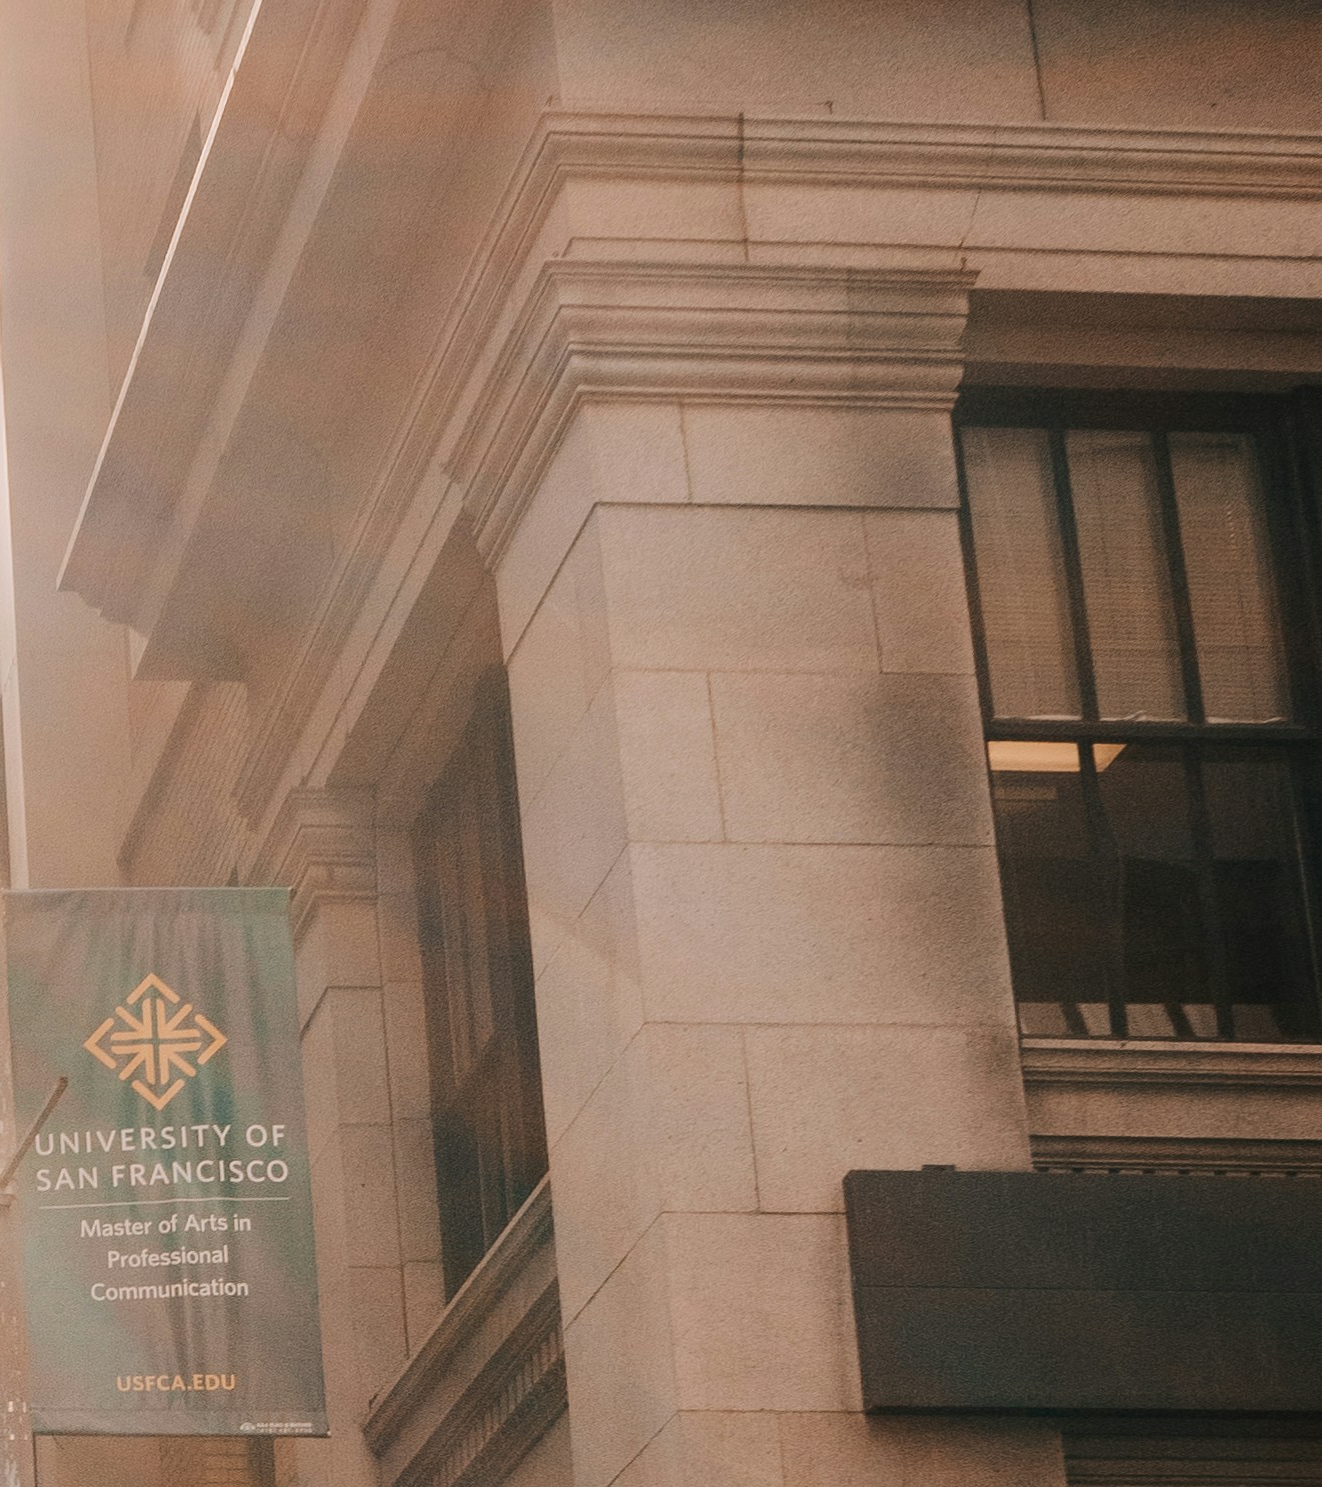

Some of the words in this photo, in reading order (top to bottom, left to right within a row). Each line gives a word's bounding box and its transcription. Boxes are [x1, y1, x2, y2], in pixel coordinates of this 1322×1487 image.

[34, 1124, 232, 1157] UNIVERSITY
[244, 1124, 286, 1148] OF
[35, 1167, 100, 1192] SAN
[111, 1159, 289, 1189] FRANCISCO
[79, 1218, 152, 1239] Master
[158, 1215, 178, 1235] of
[183, 1214, 228, 1234] Arts
[232, 1214, 252, 1232] in
[106, 1245, 229, 1269] Professional
[90, 1277, 249, 1303] Communication
[115, 1374, 237, 1393] USFCA.EDU
